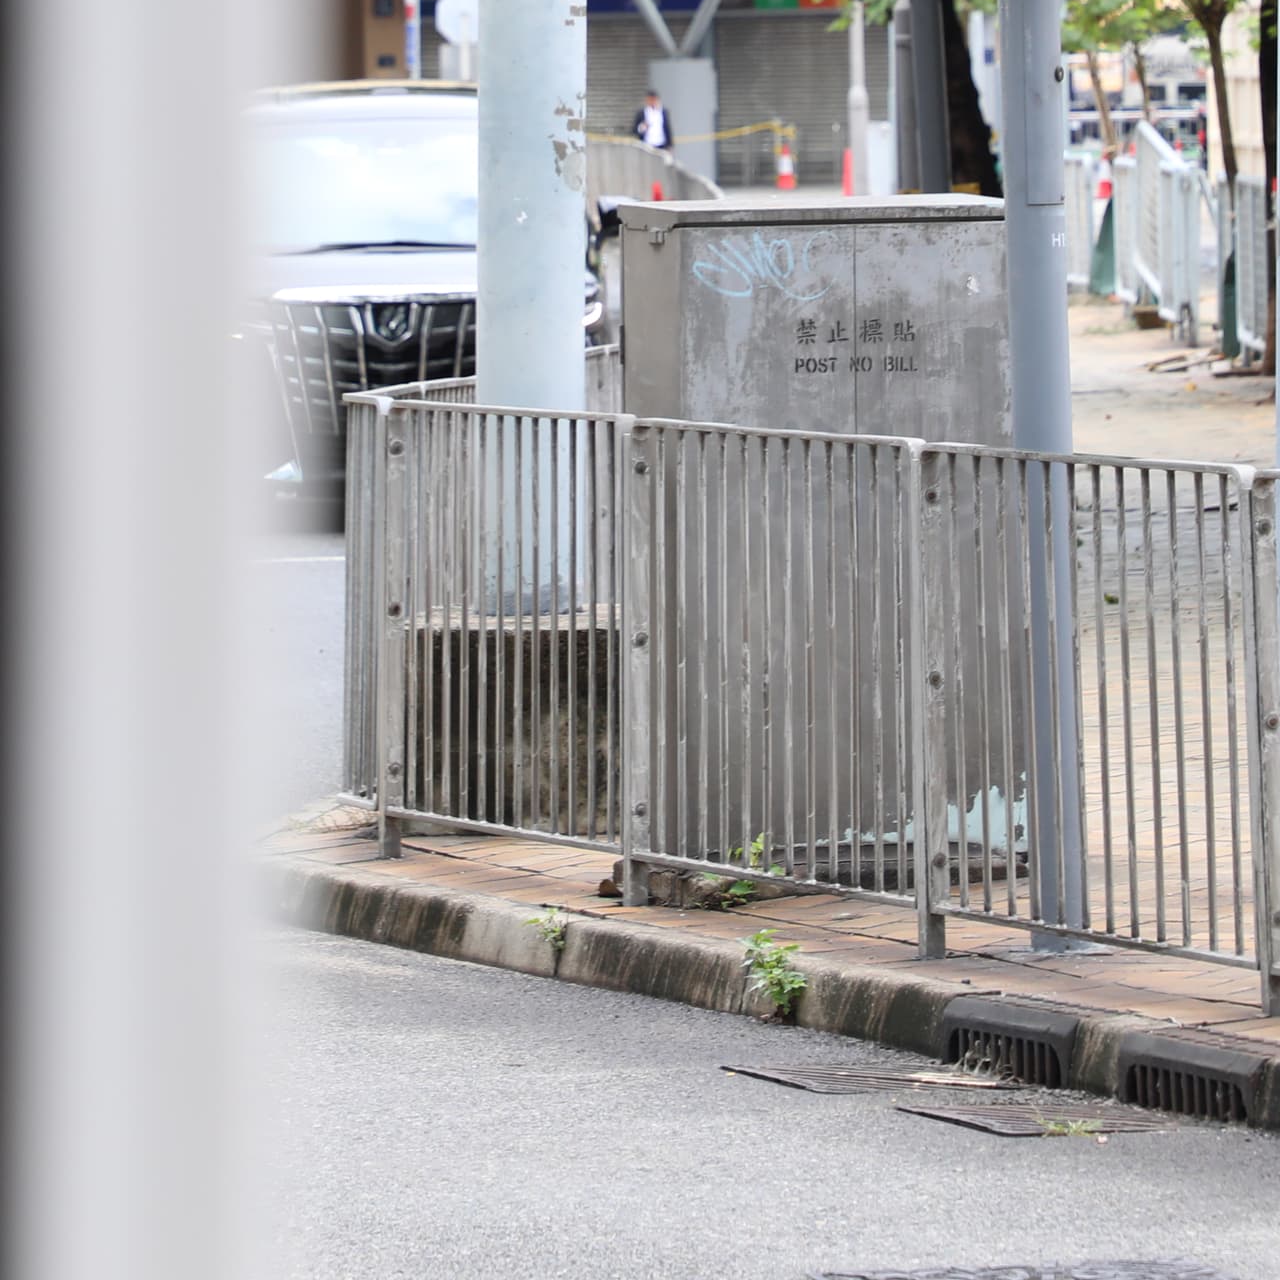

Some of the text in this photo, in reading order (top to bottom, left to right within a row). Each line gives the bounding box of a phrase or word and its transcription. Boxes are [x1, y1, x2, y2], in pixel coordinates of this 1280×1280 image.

[796, 319, 915, 345] 禁止標貼
[794, 356, 919, 374] POST NO BILL
